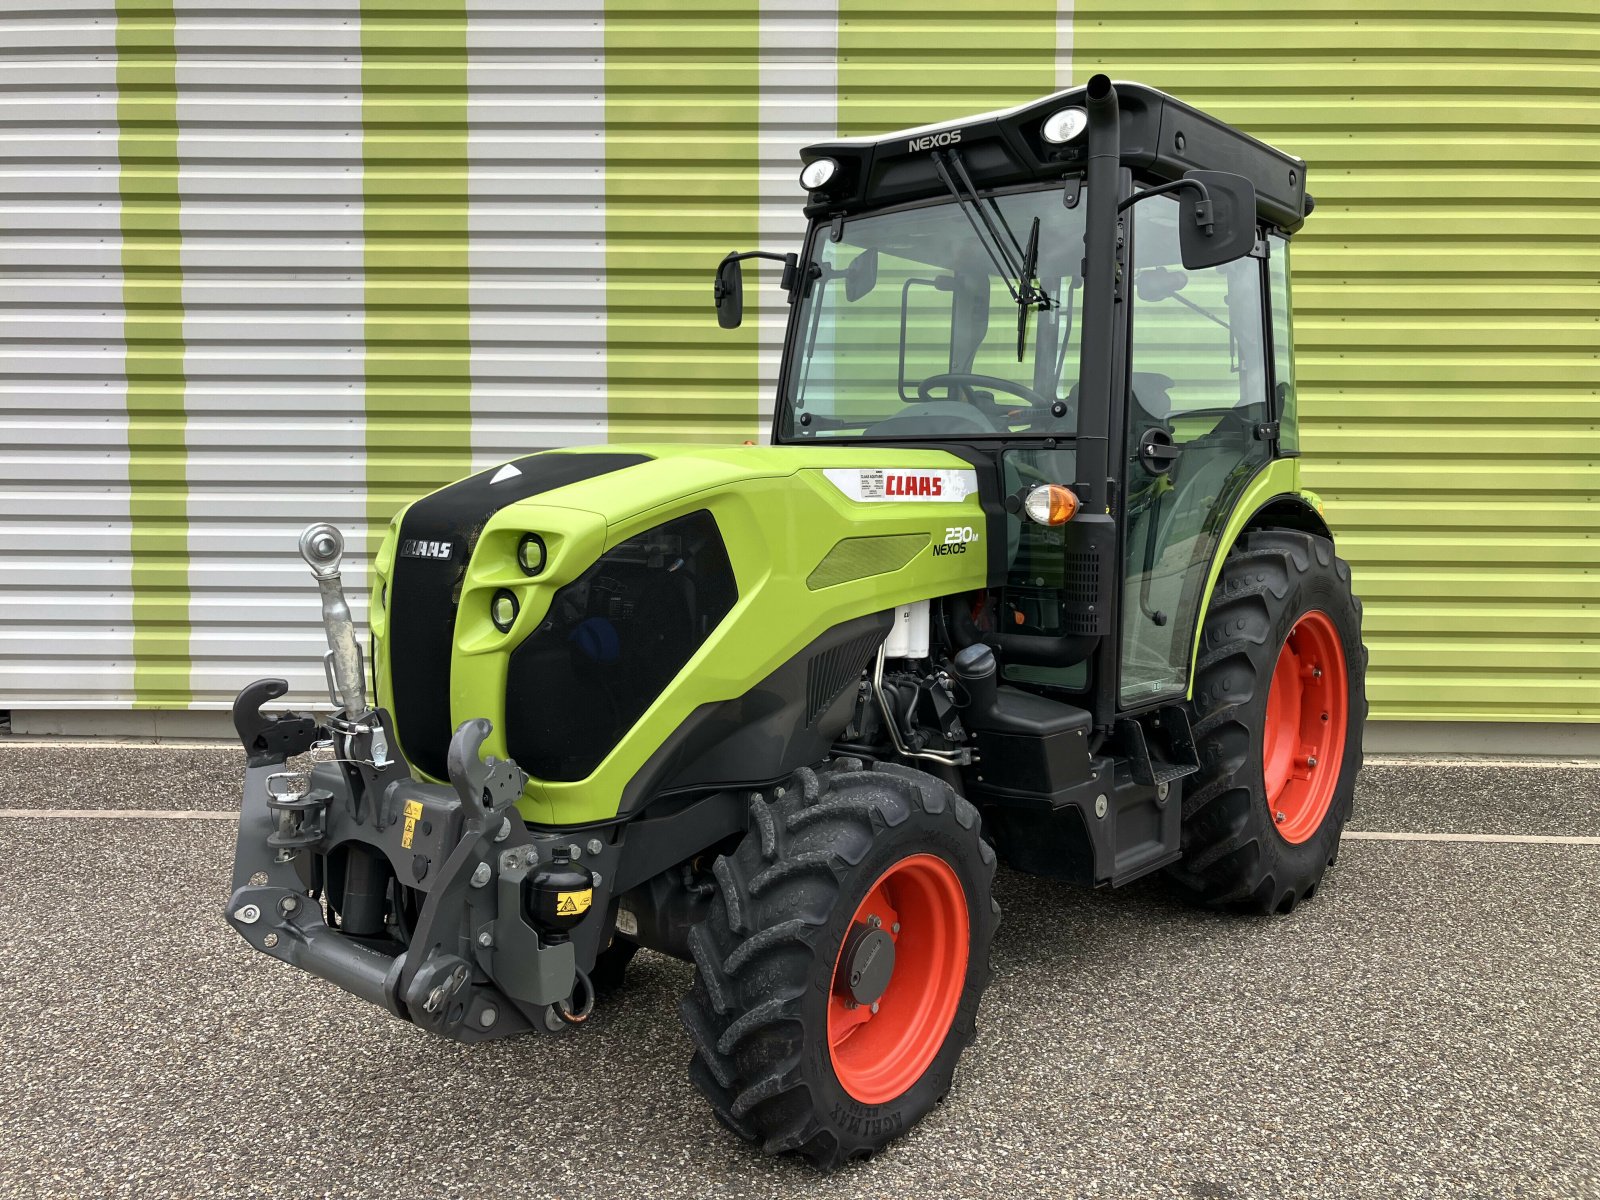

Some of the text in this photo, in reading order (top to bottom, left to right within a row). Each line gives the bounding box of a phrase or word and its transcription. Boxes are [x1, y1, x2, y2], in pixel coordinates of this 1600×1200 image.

[908, 130, 962, 153] NEXOS
[885, 475, 942, 496] CLAAS
[932, 542, 967, 556] NEXOS
